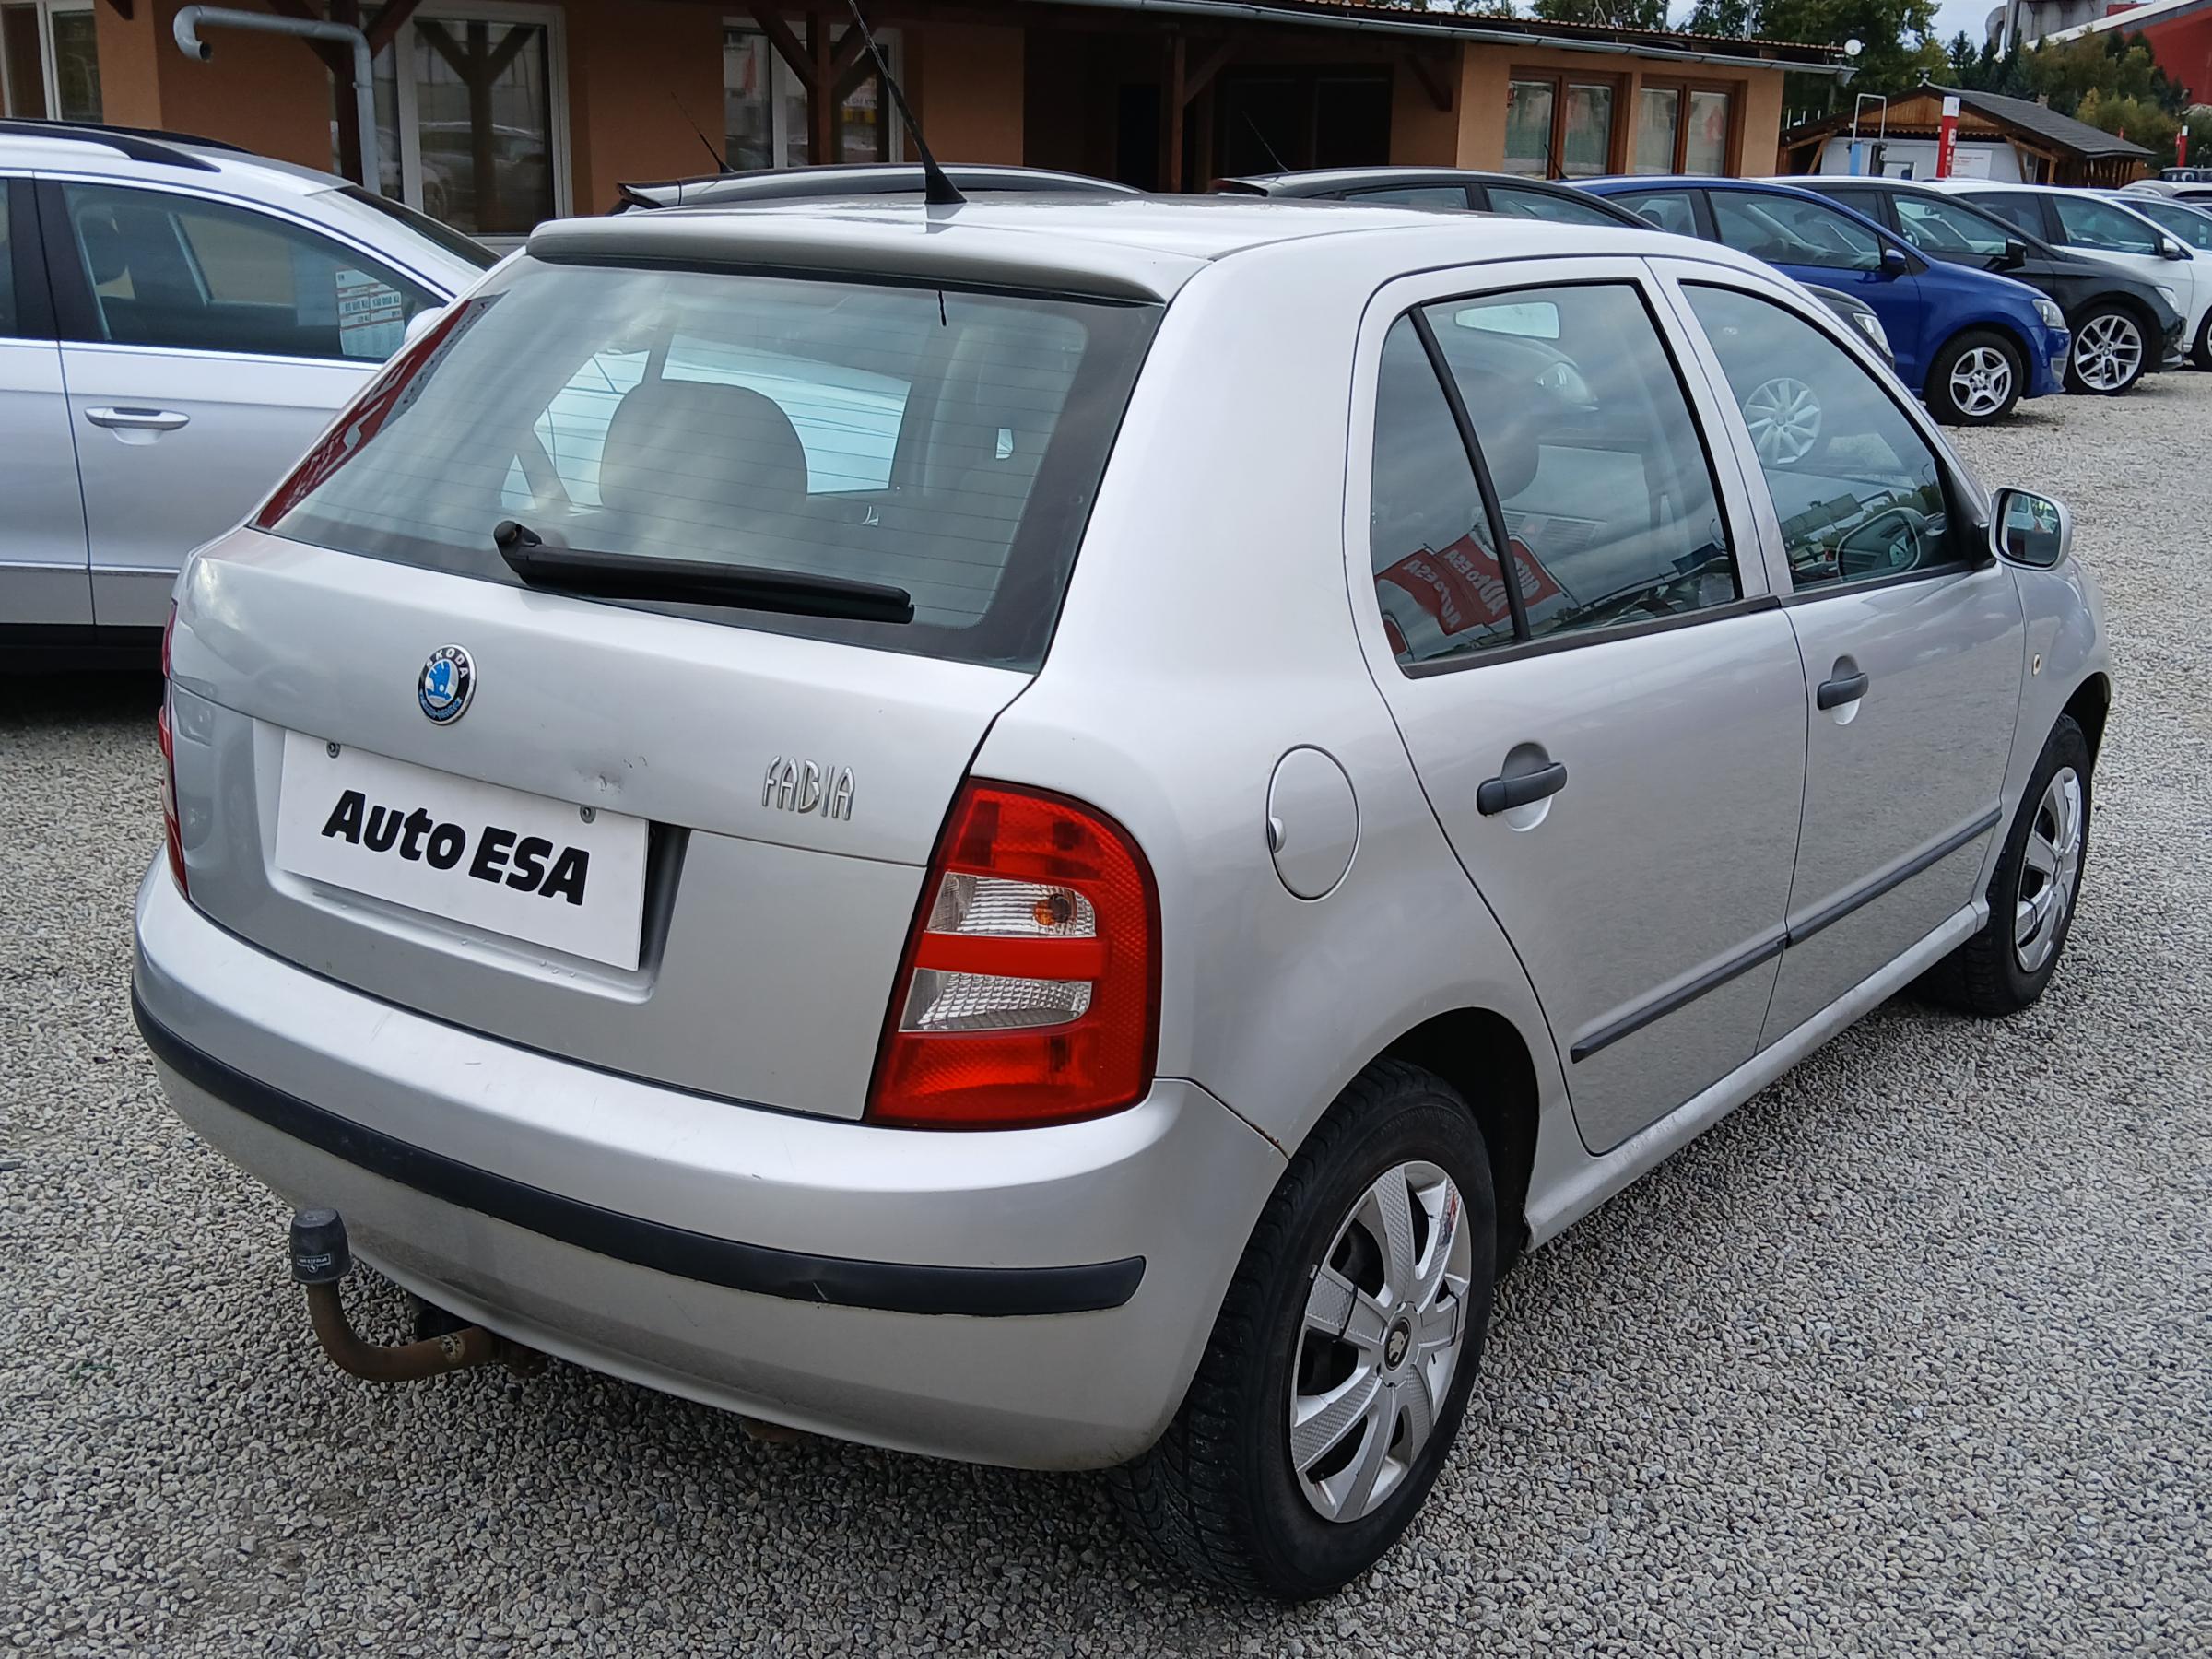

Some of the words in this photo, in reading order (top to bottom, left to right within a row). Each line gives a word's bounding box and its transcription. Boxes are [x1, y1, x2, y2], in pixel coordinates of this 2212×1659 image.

[762, 755, 854, 821] FABIA
[321, 789, 466, 871] Auto
[468, 826, 590, 906] ESA
